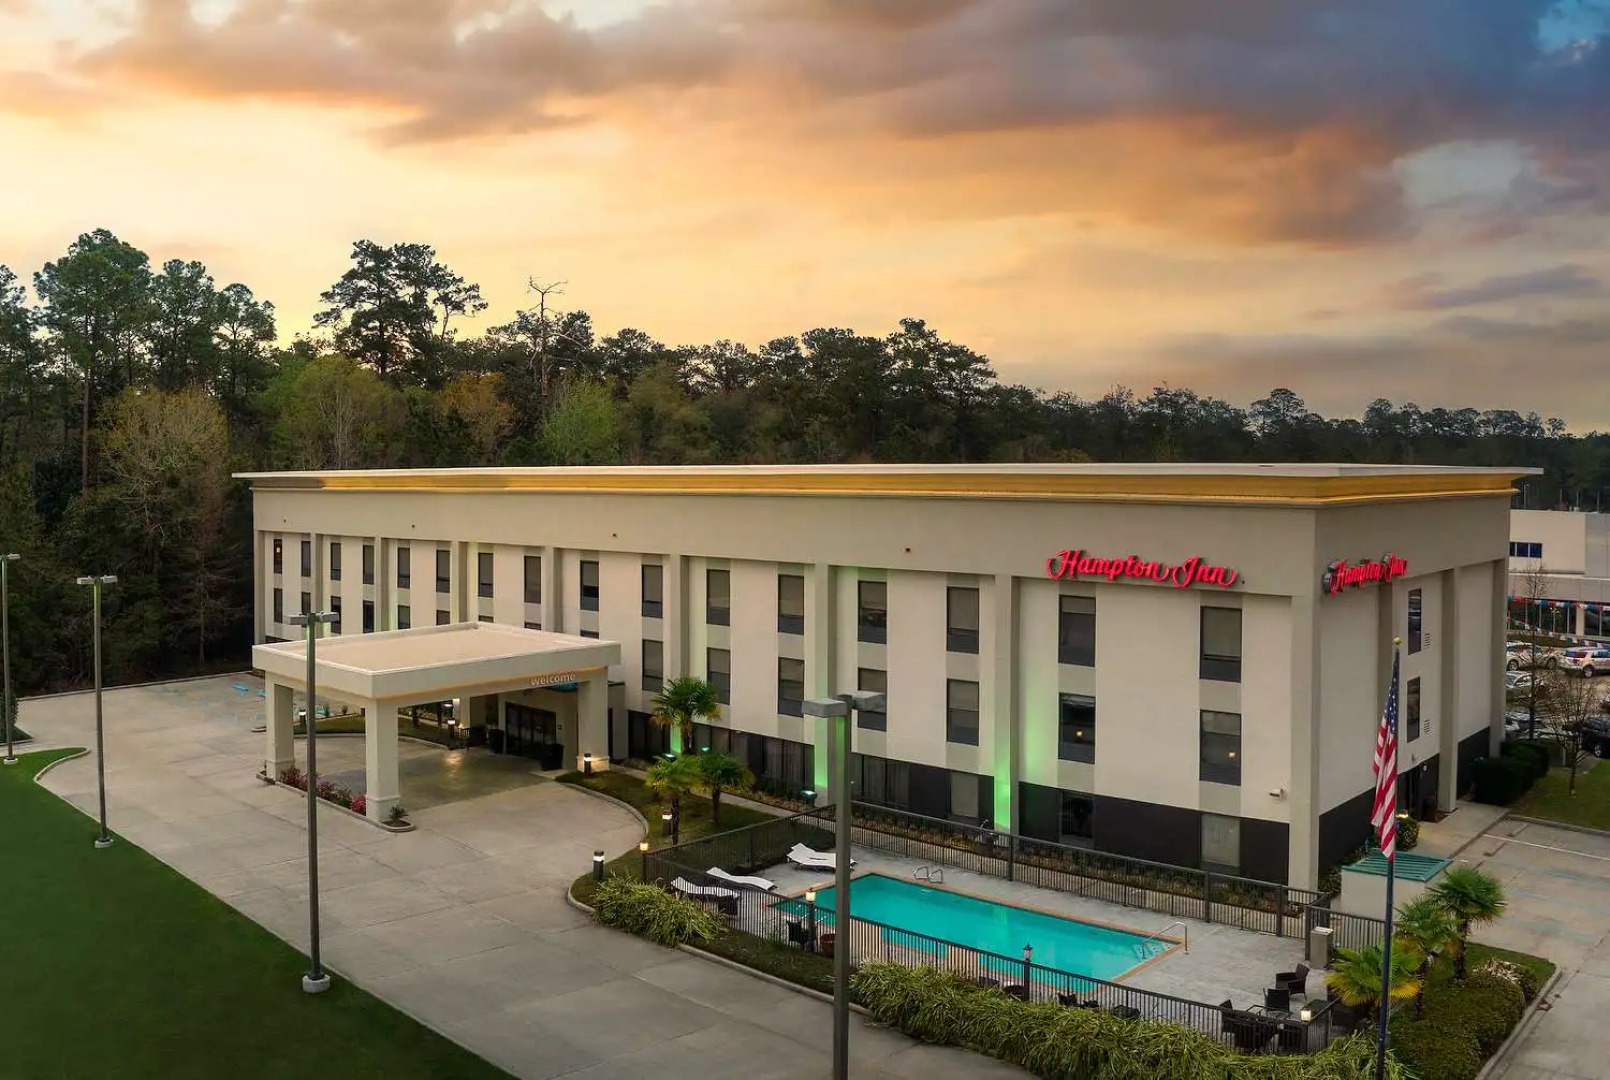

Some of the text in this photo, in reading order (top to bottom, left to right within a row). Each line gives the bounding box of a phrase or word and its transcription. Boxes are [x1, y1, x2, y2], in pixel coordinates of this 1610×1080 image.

[1047, 550, 1237, 588] Hampton Inn
[1327, 552, 1407, 597] Hampton Inn
[530, 673, 576, 686] welcome
